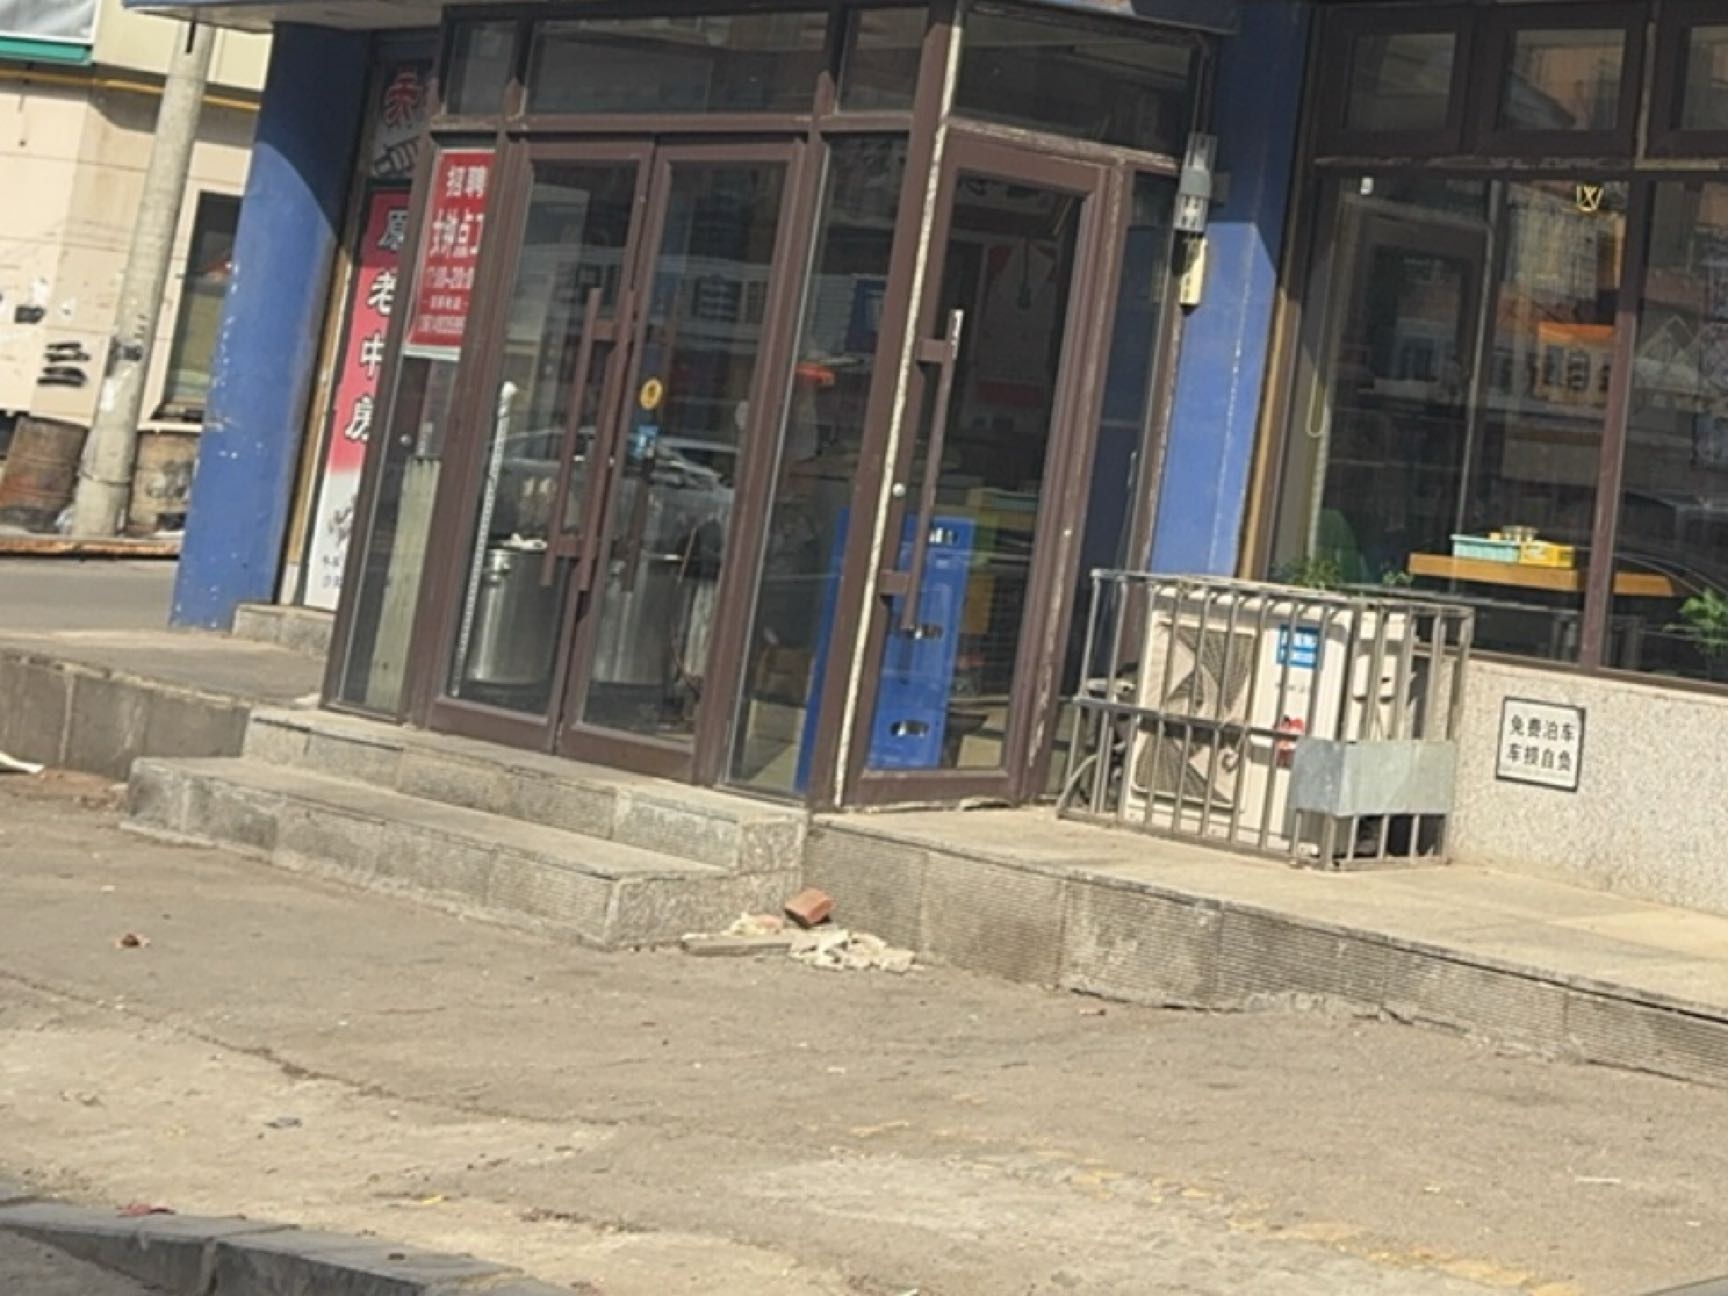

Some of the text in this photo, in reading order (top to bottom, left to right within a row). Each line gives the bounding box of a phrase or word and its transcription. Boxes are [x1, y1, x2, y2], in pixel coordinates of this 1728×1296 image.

[446, 164, 489, 199] 招聘
[1509, 713, 1576, 742] 免费泊车
[1505, 742, 1571, 772] 车损自负
